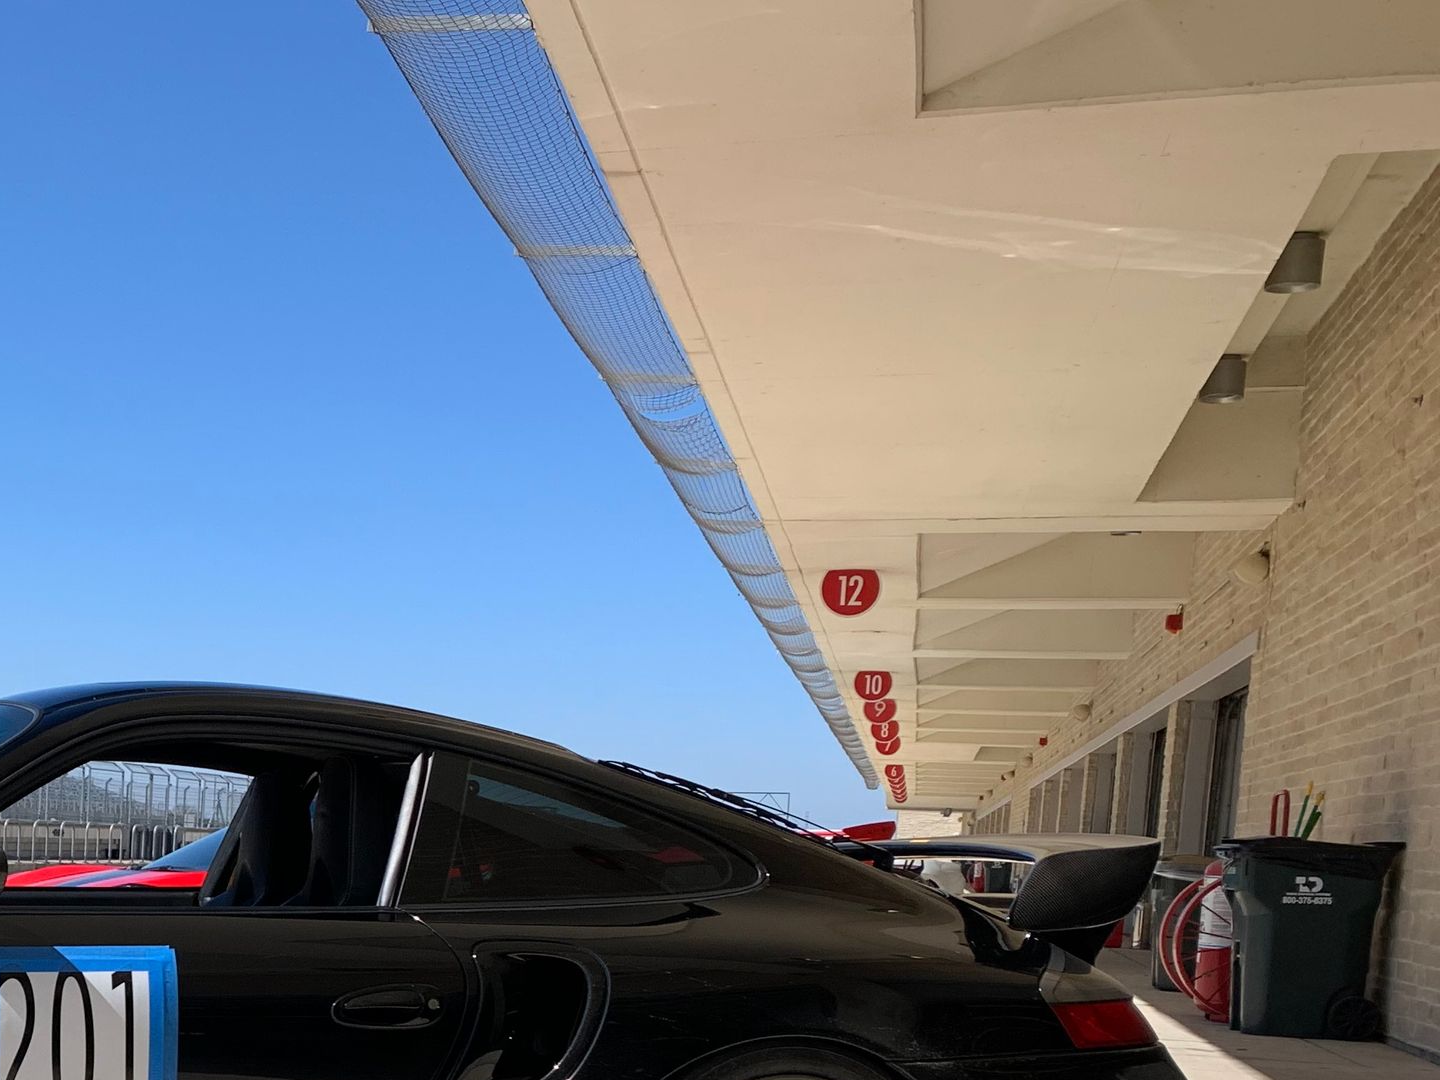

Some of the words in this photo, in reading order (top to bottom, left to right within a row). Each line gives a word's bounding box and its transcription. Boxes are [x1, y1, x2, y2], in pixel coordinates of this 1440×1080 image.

[838, 575, 864, 606] 12
[864, 674, 883, 694] 10
[874, 701, 886, 717] 9
[880, 723, 889, 738] 8
[890, 766, 897, 777] 6
